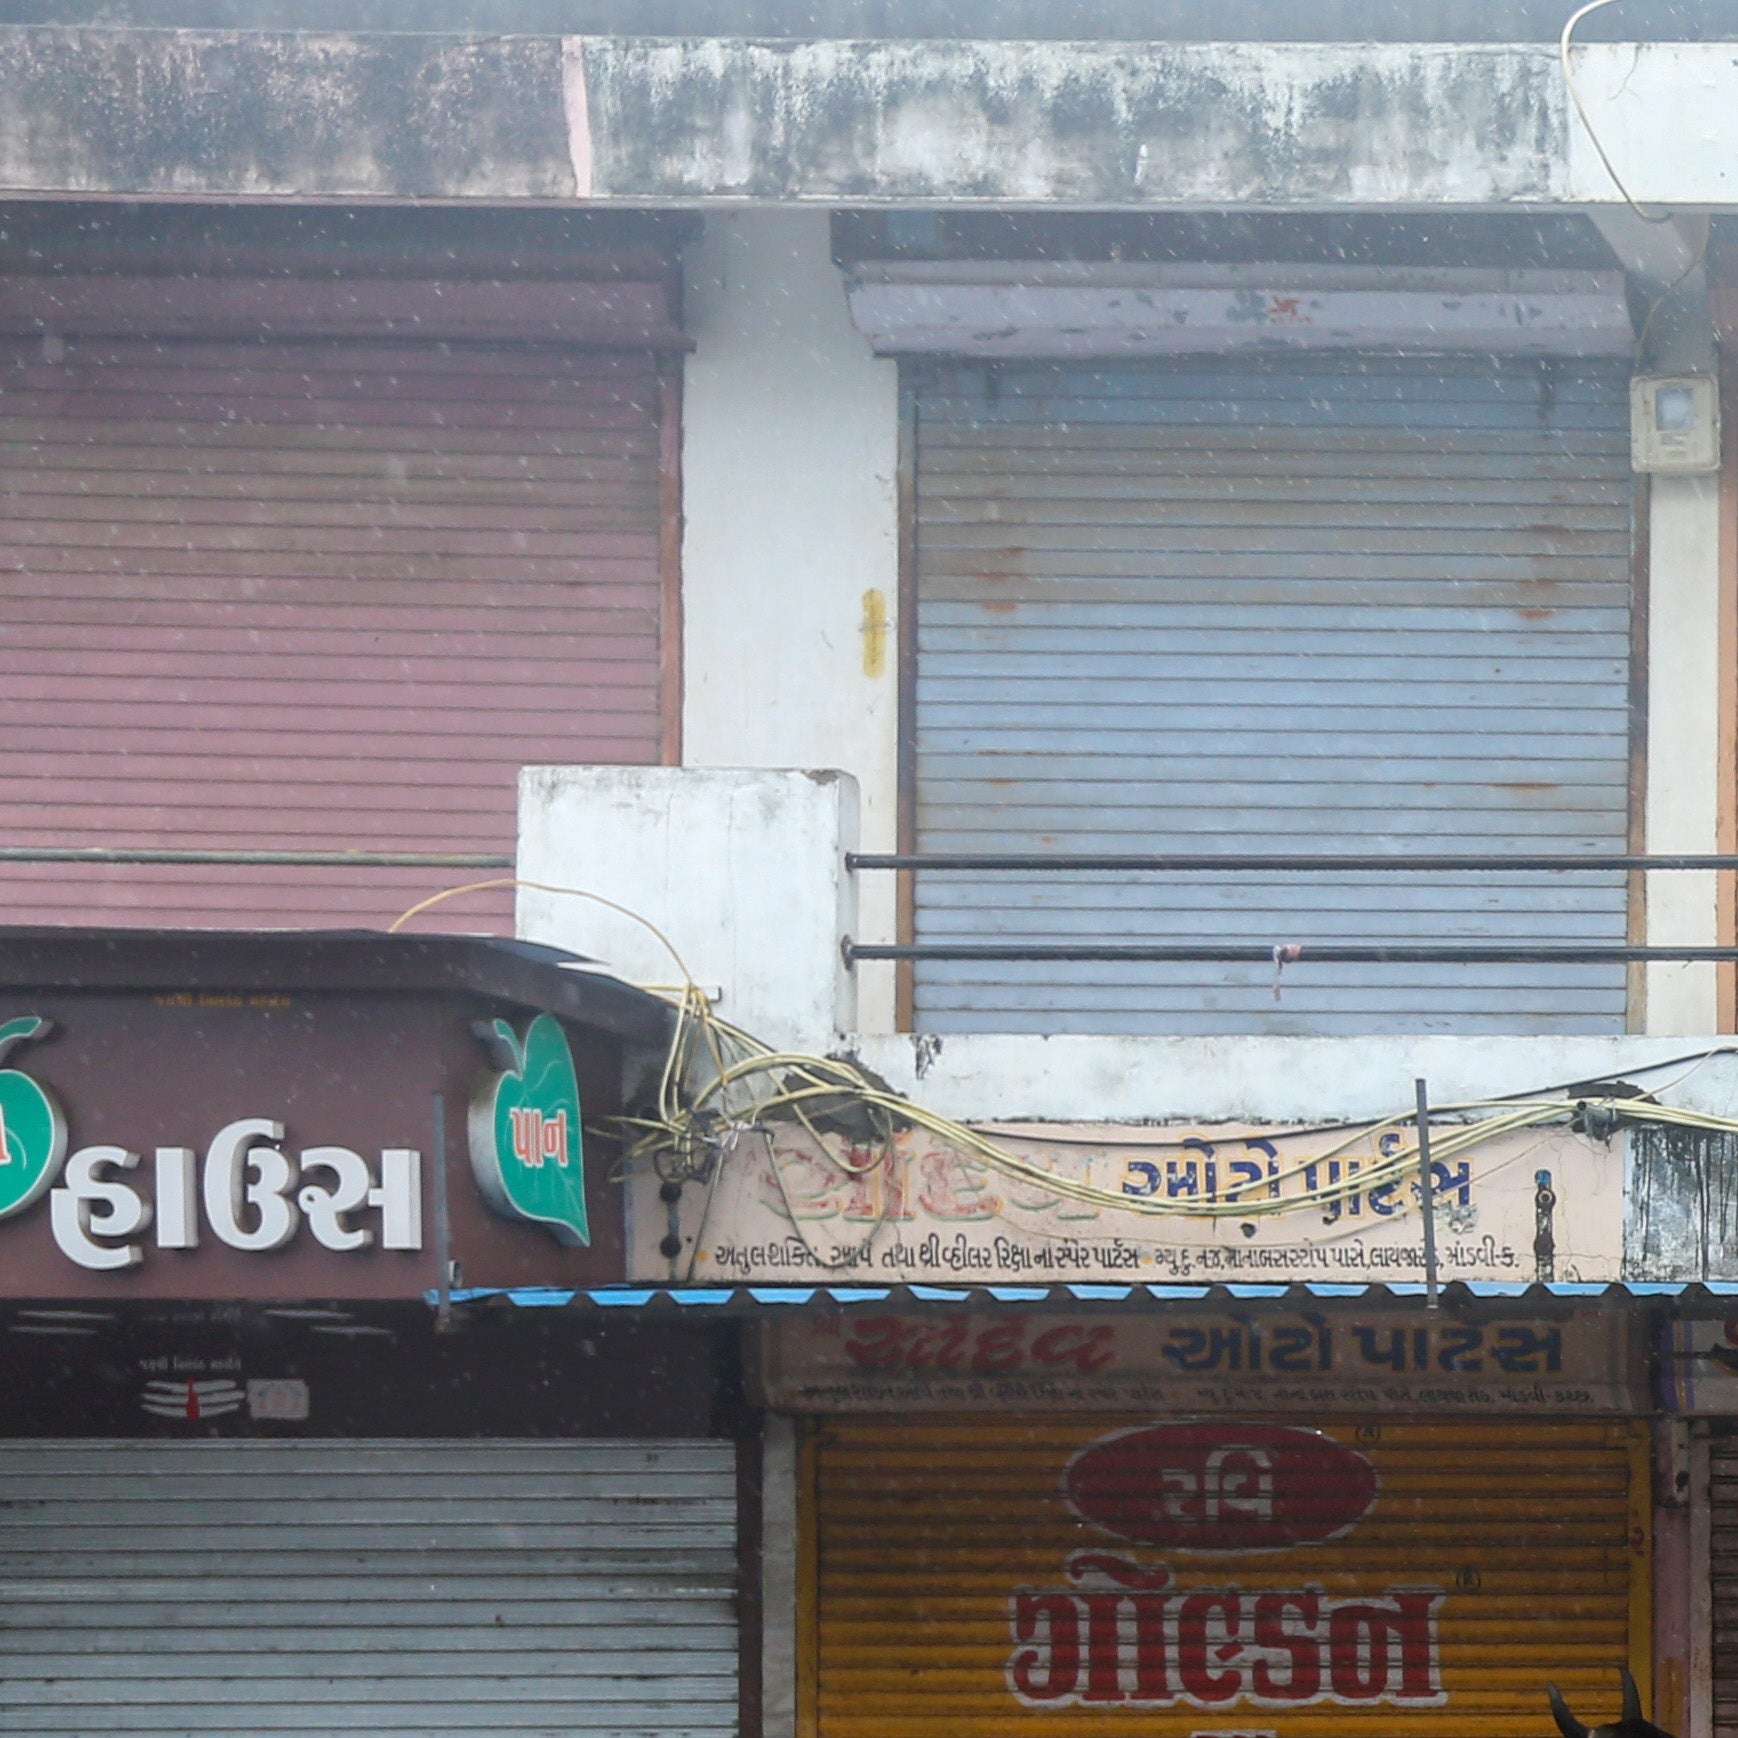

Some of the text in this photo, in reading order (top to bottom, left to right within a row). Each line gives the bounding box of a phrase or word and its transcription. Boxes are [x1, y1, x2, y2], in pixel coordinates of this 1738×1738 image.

[507, 1106, 569, 1171] પાન
[51, 1118, 422, 1270] હાઉસ
[1162, 1311, 1334, 1372] ઓટો
[1160, 1444, 1274, 1523] રવિ
